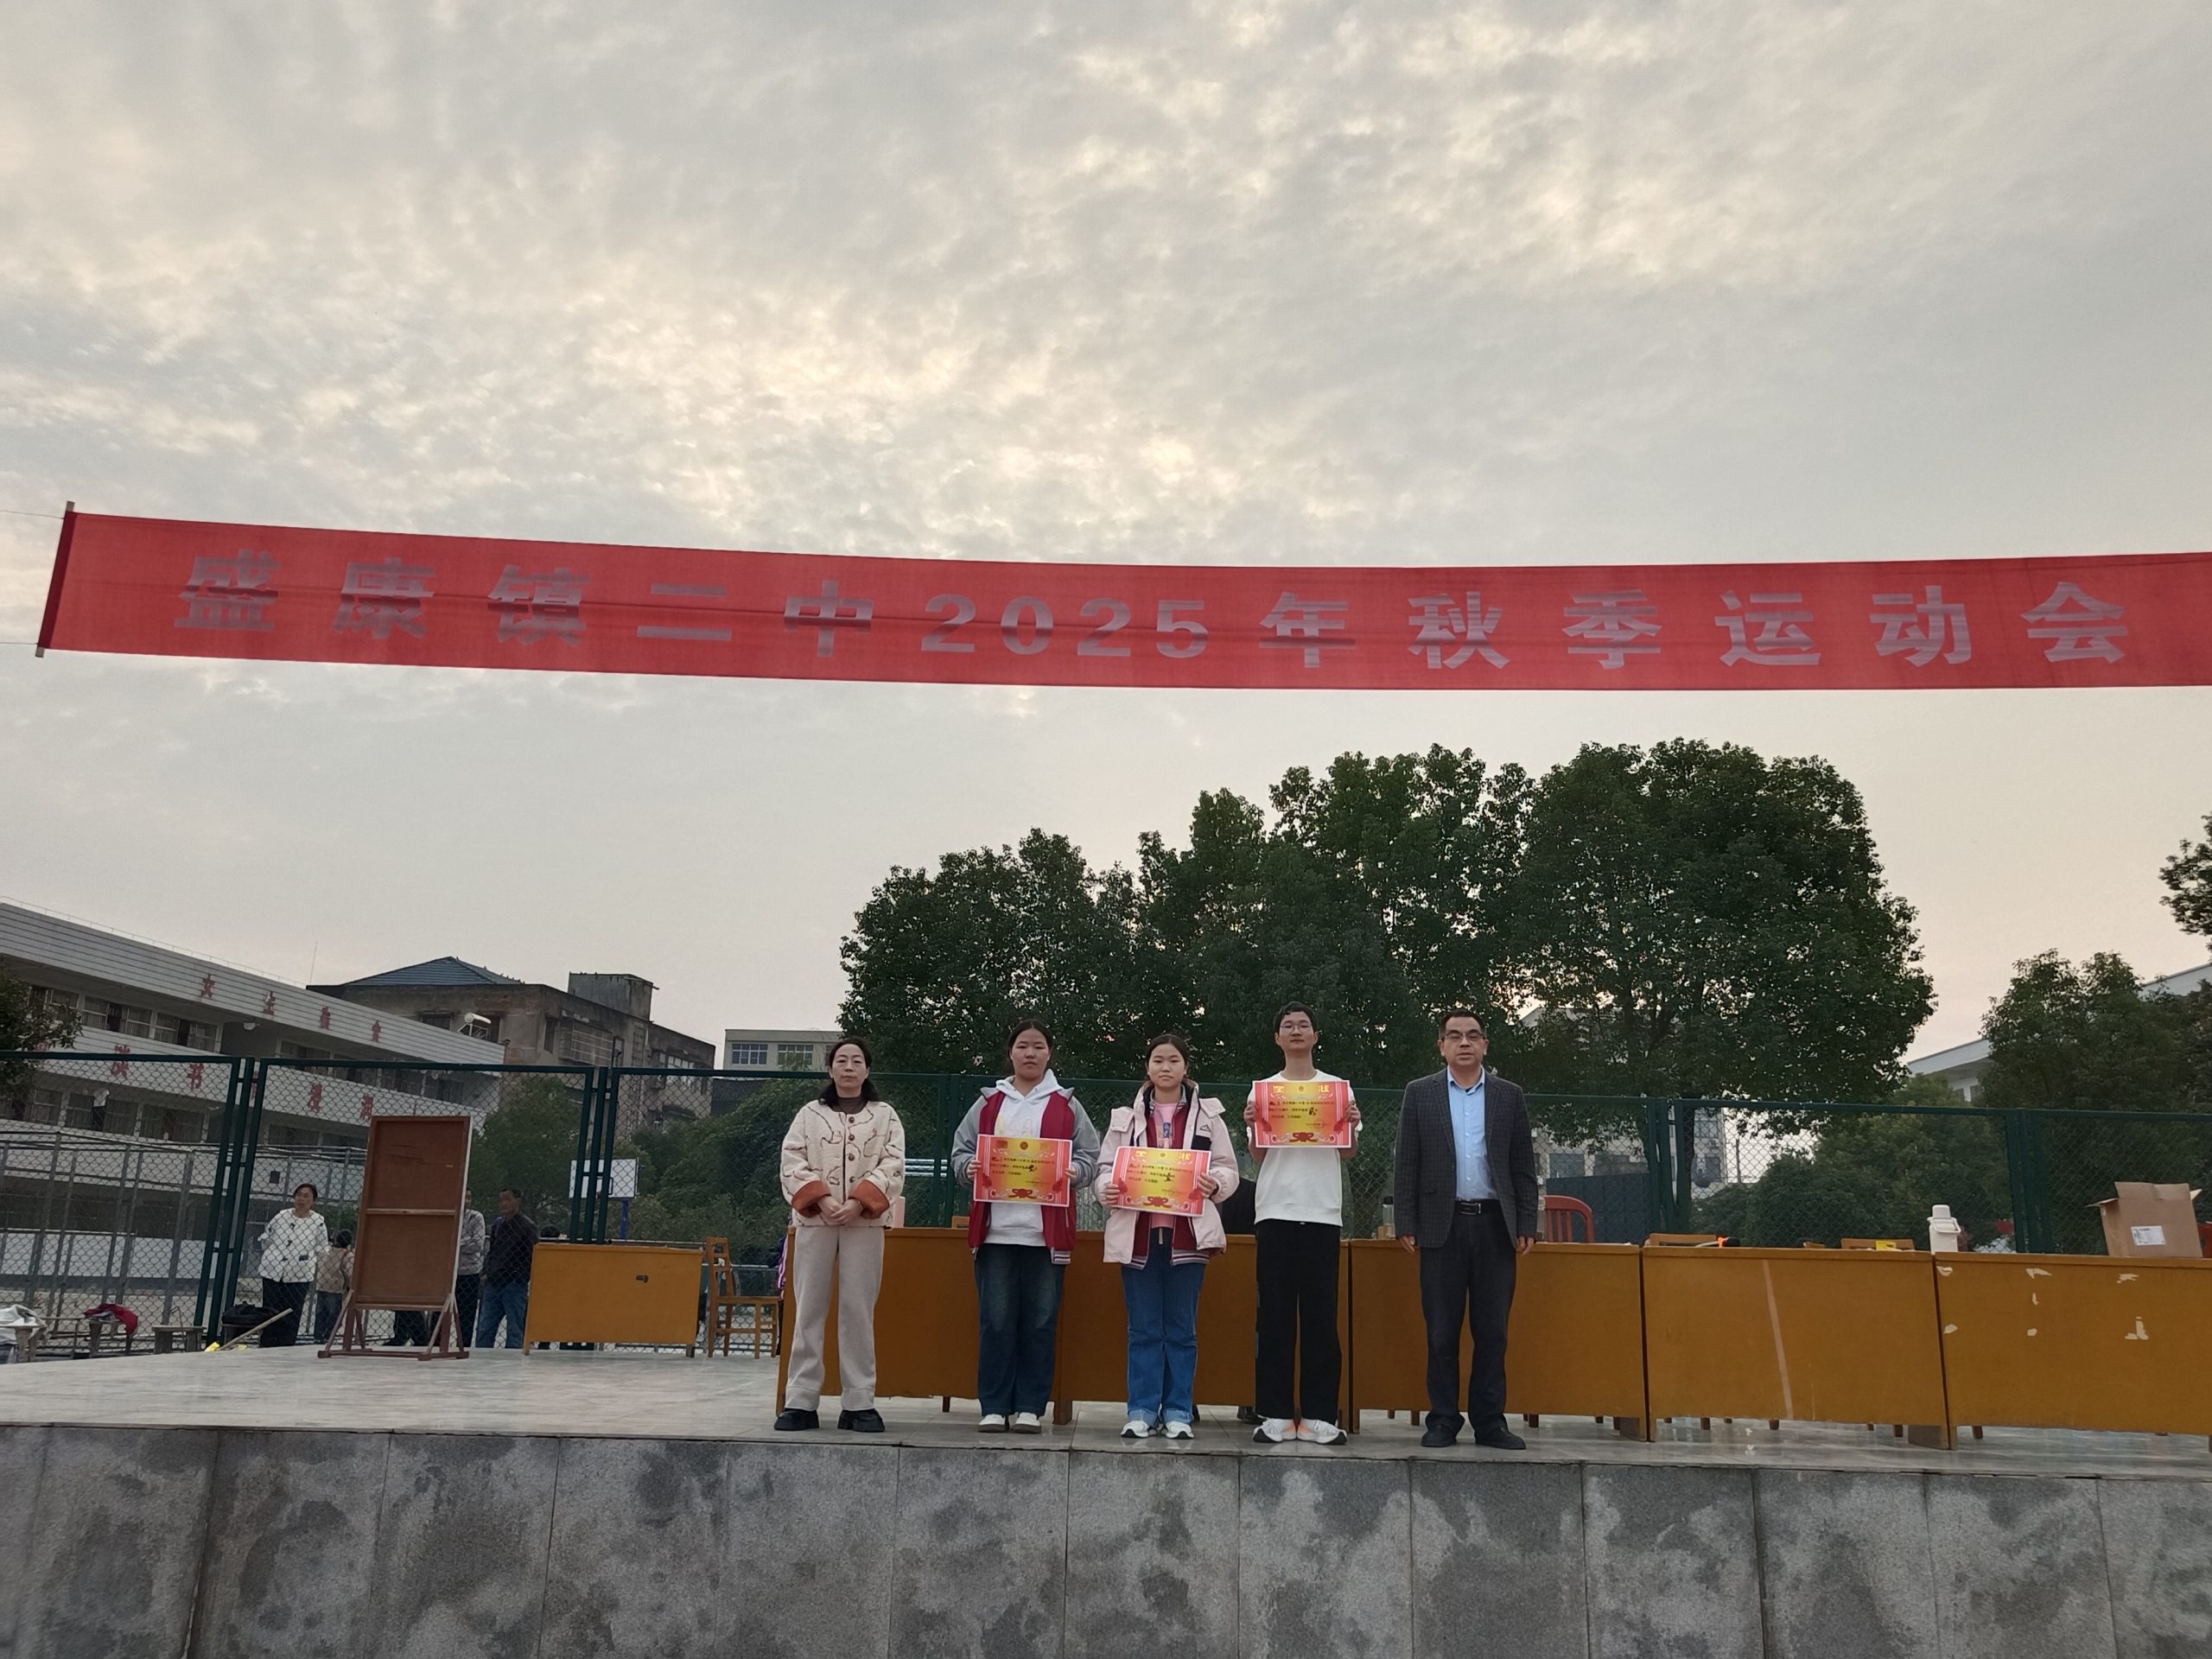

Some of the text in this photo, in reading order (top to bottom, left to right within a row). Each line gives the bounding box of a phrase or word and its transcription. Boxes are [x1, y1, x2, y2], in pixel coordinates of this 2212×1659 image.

[174, 548, 2127, 670] 盛康镇二中2025年秋季运动会
